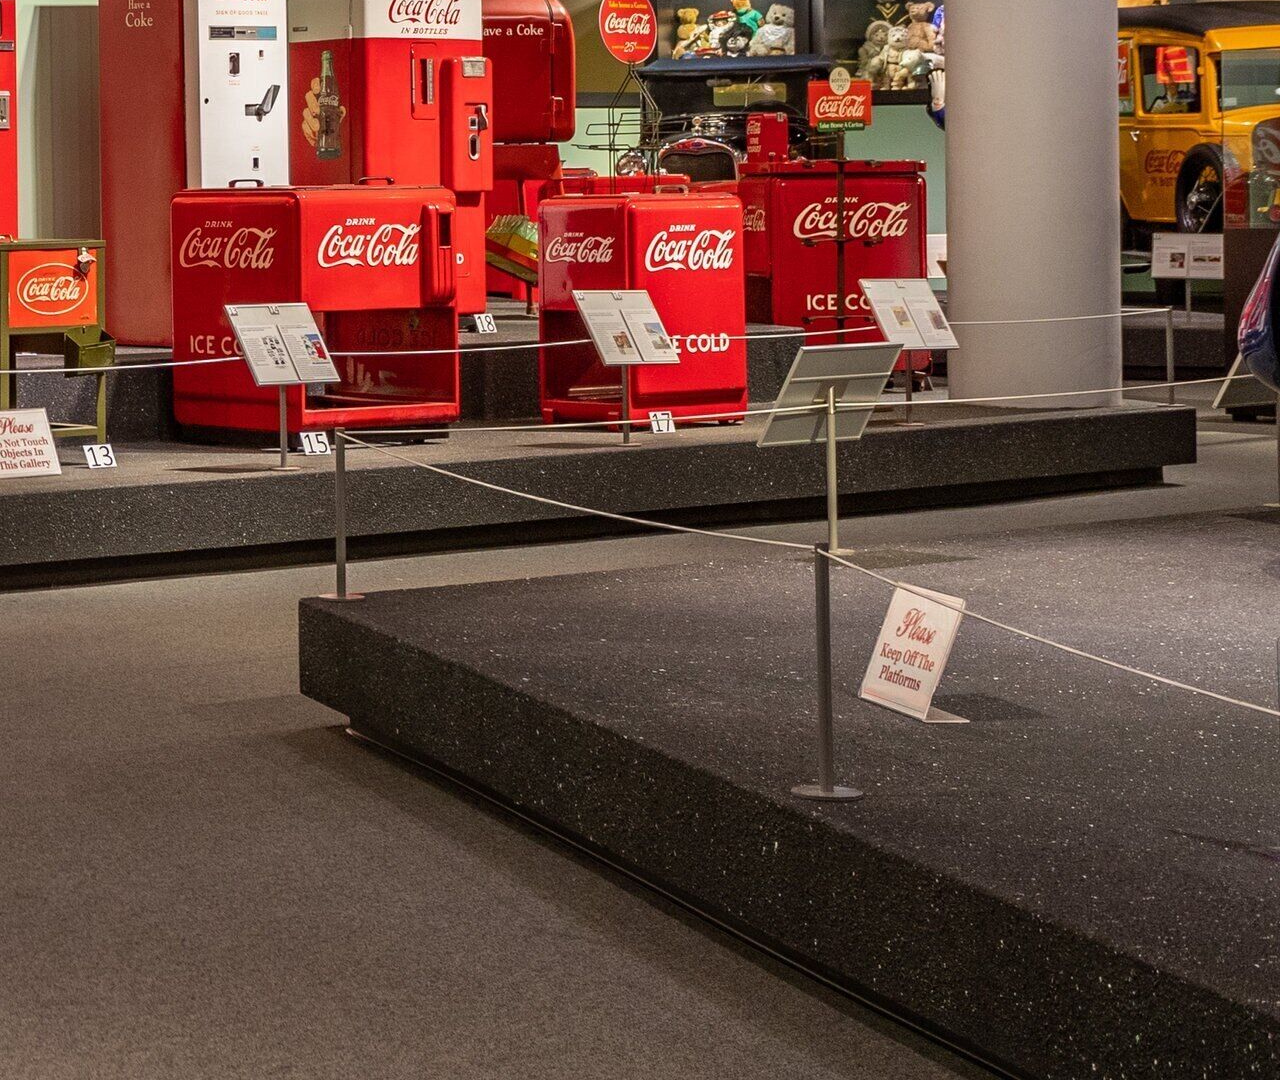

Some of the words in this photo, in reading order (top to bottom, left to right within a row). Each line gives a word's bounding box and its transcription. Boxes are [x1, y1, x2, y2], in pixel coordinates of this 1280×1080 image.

[128, 0, 145, 10] Have
[125, 11, 154, 29] Coke
[604, 12, 651, 35] Coca-Cola
[400, 27, 411, 35] IN
[412, 27, 449, 35] BOTTLES
[482, 25, 502, 37] ave
[506, 28, 513, 36] a
[516, 24, 544, 37] Coke
[814, 95, 867, 118] Coca-Cola
[824, 196, 859, 204] DRNK
[204, 220, 234, 228] DRINK
[344, 217, 376, 226] DRINK
[669, 224, 696, 232] DRINK
[179, 227, 278, 269] Coca-Cola
[317, 223, 422, 268] Coca-Cola
[545, 236, 616, 264] Coca-Cola
[644, 228, 736, 272] Coca-Cola
[23, 276, 81, 303] Coca-Cola
[806, 294, 838, 311] ICE
[844, 294, 871, 311] CO
[476, 314, 495, 333] 18
[189, 334, 216, 355] ICE
[221, 336, 245, 356] CO
[686, 332, 730, 353] COLD
[652, 412, 671, 432] 17
[3, 438, 21, 448] Not
[20, 437, 49, 447] Touch
[304, 434, 329, 454] 15
[0, 449, 33, 459] Objects
[34, 448, 44, 457] In
[86, 445, 114, 468] 13
[19, 458, 52, 471] Gallery
[895, 607, 937, 645] Please
[880, 642, 903, 665] Keep
[902, 647, 920, 666] Off
[918, 651, 935, 672] The
[878, 664, 922, 692] Platforms
